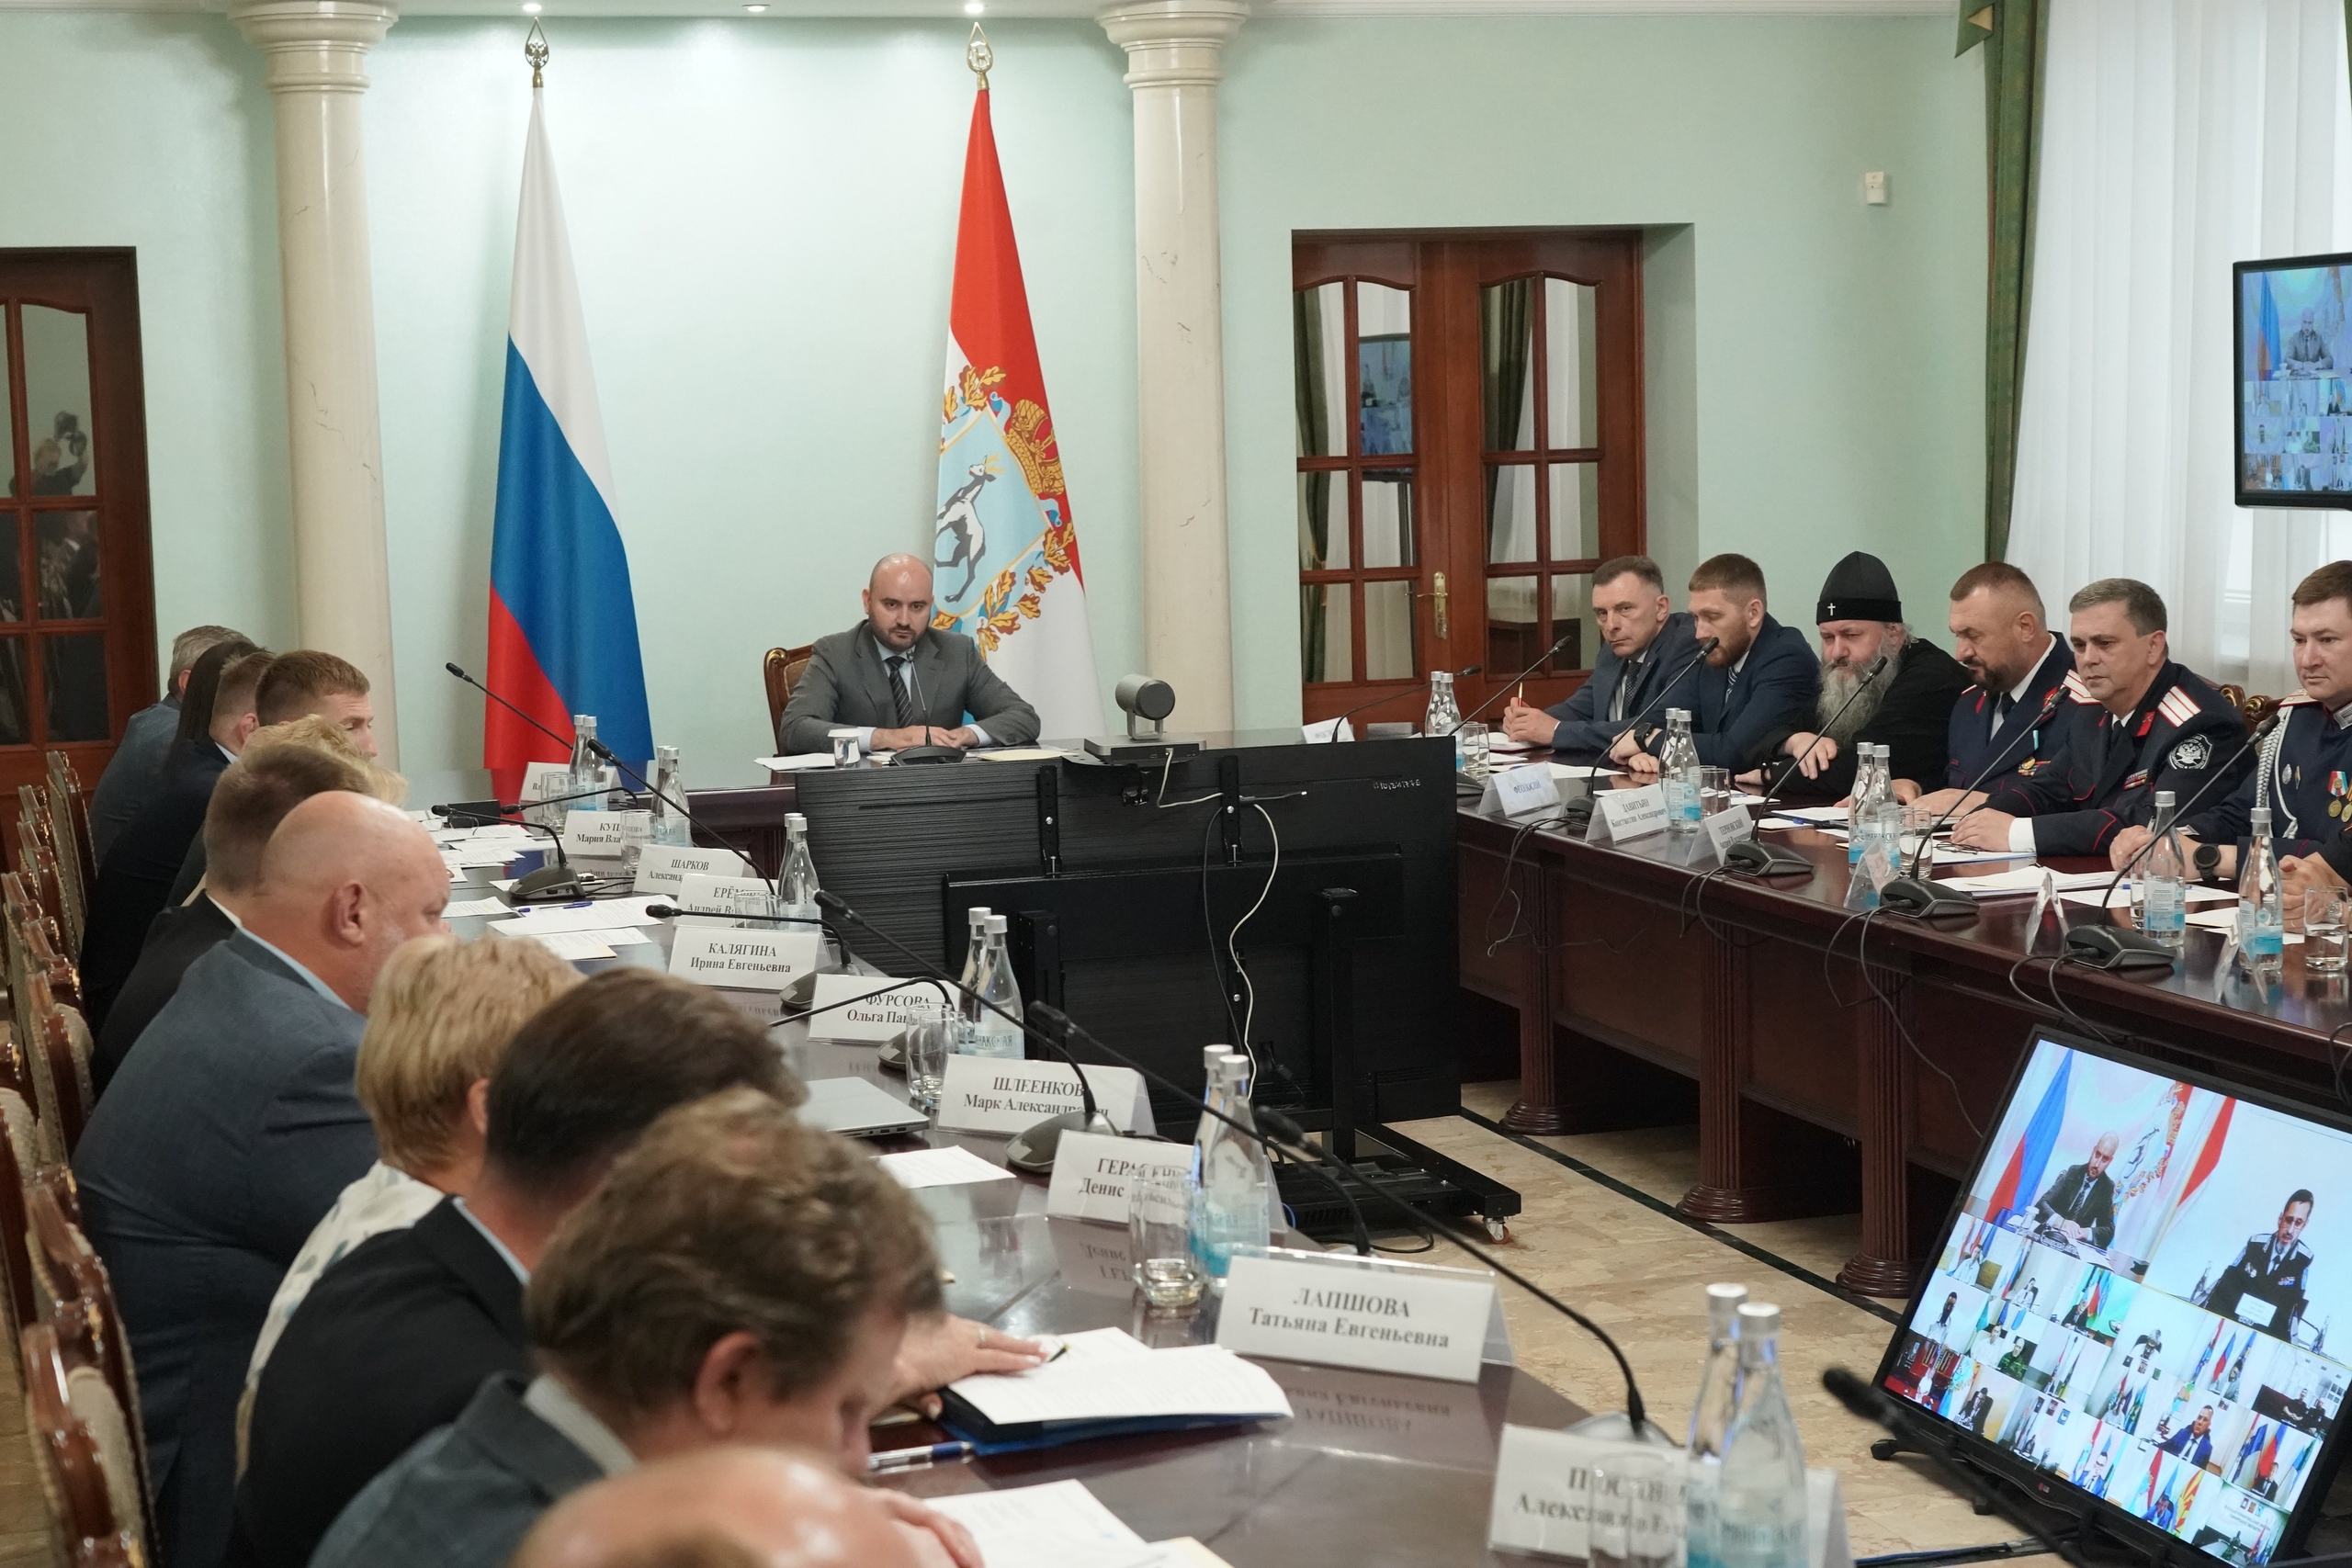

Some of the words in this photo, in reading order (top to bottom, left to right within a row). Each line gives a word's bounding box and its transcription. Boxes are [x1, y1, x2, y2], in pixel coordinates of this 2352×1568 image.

[576, 832, 604, 845] Мария
[670, 858, 710, 872] ШАРКОВ
[707, 942, 777, 957] КАЛЯГИНА
[690, 956, 725, 971] Ирина
[728, 958, 792, 974] Евгеньевна
[846, 1009, 884, 1023] Ольга
[992, 1076, 1085, 1097] ШЛЕЕНКОВ
[964, 1092, 1002, 1113] Марк
[1078, 1177, 1125, 1199] Денис
[1293, 1287, 1411, 1318] ЛАПШОВА
[1249, 1306, 1328, 1334] Татьяна
[1334, 1316, 1450, 1348] Евгеньевна
